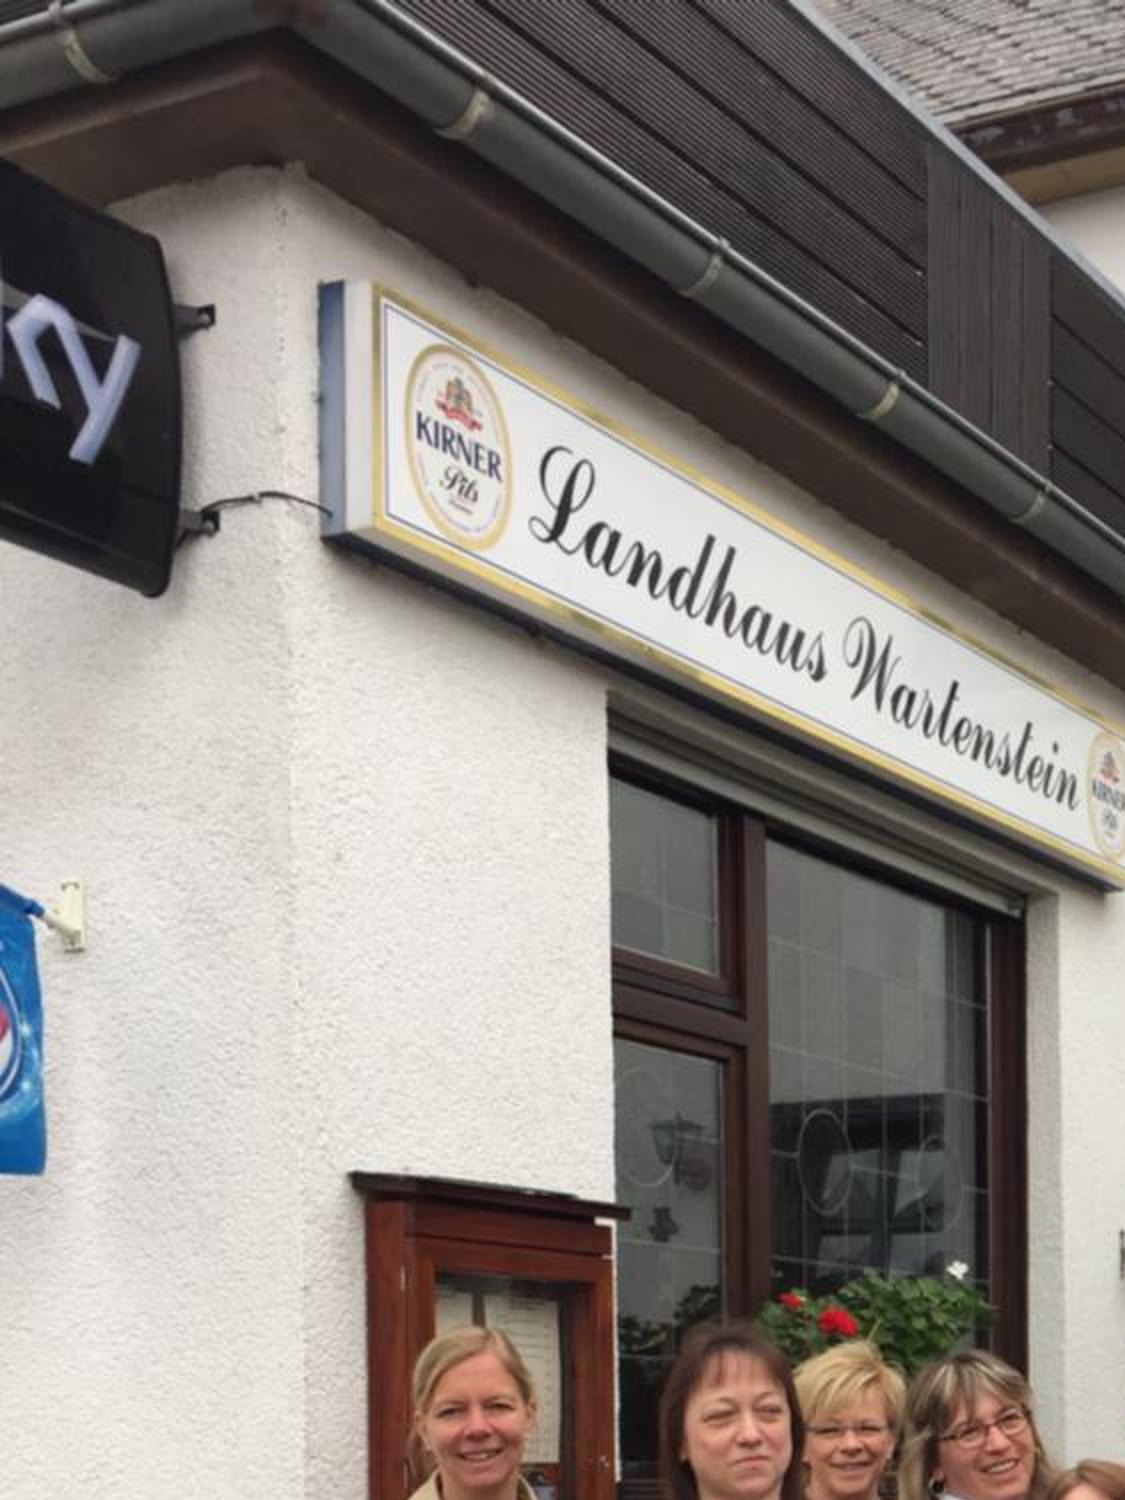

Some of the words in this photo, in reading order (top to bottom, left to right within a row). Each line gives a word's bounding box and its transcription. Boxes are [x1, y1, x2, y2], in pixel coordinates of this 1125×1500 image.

[416, 411, 503, 483] KIRNER
[439, 465, 479, 503] Pils
[528, 446, 828, 682] Landhaus
[843, 616, 1080, 810] Wartenstein
